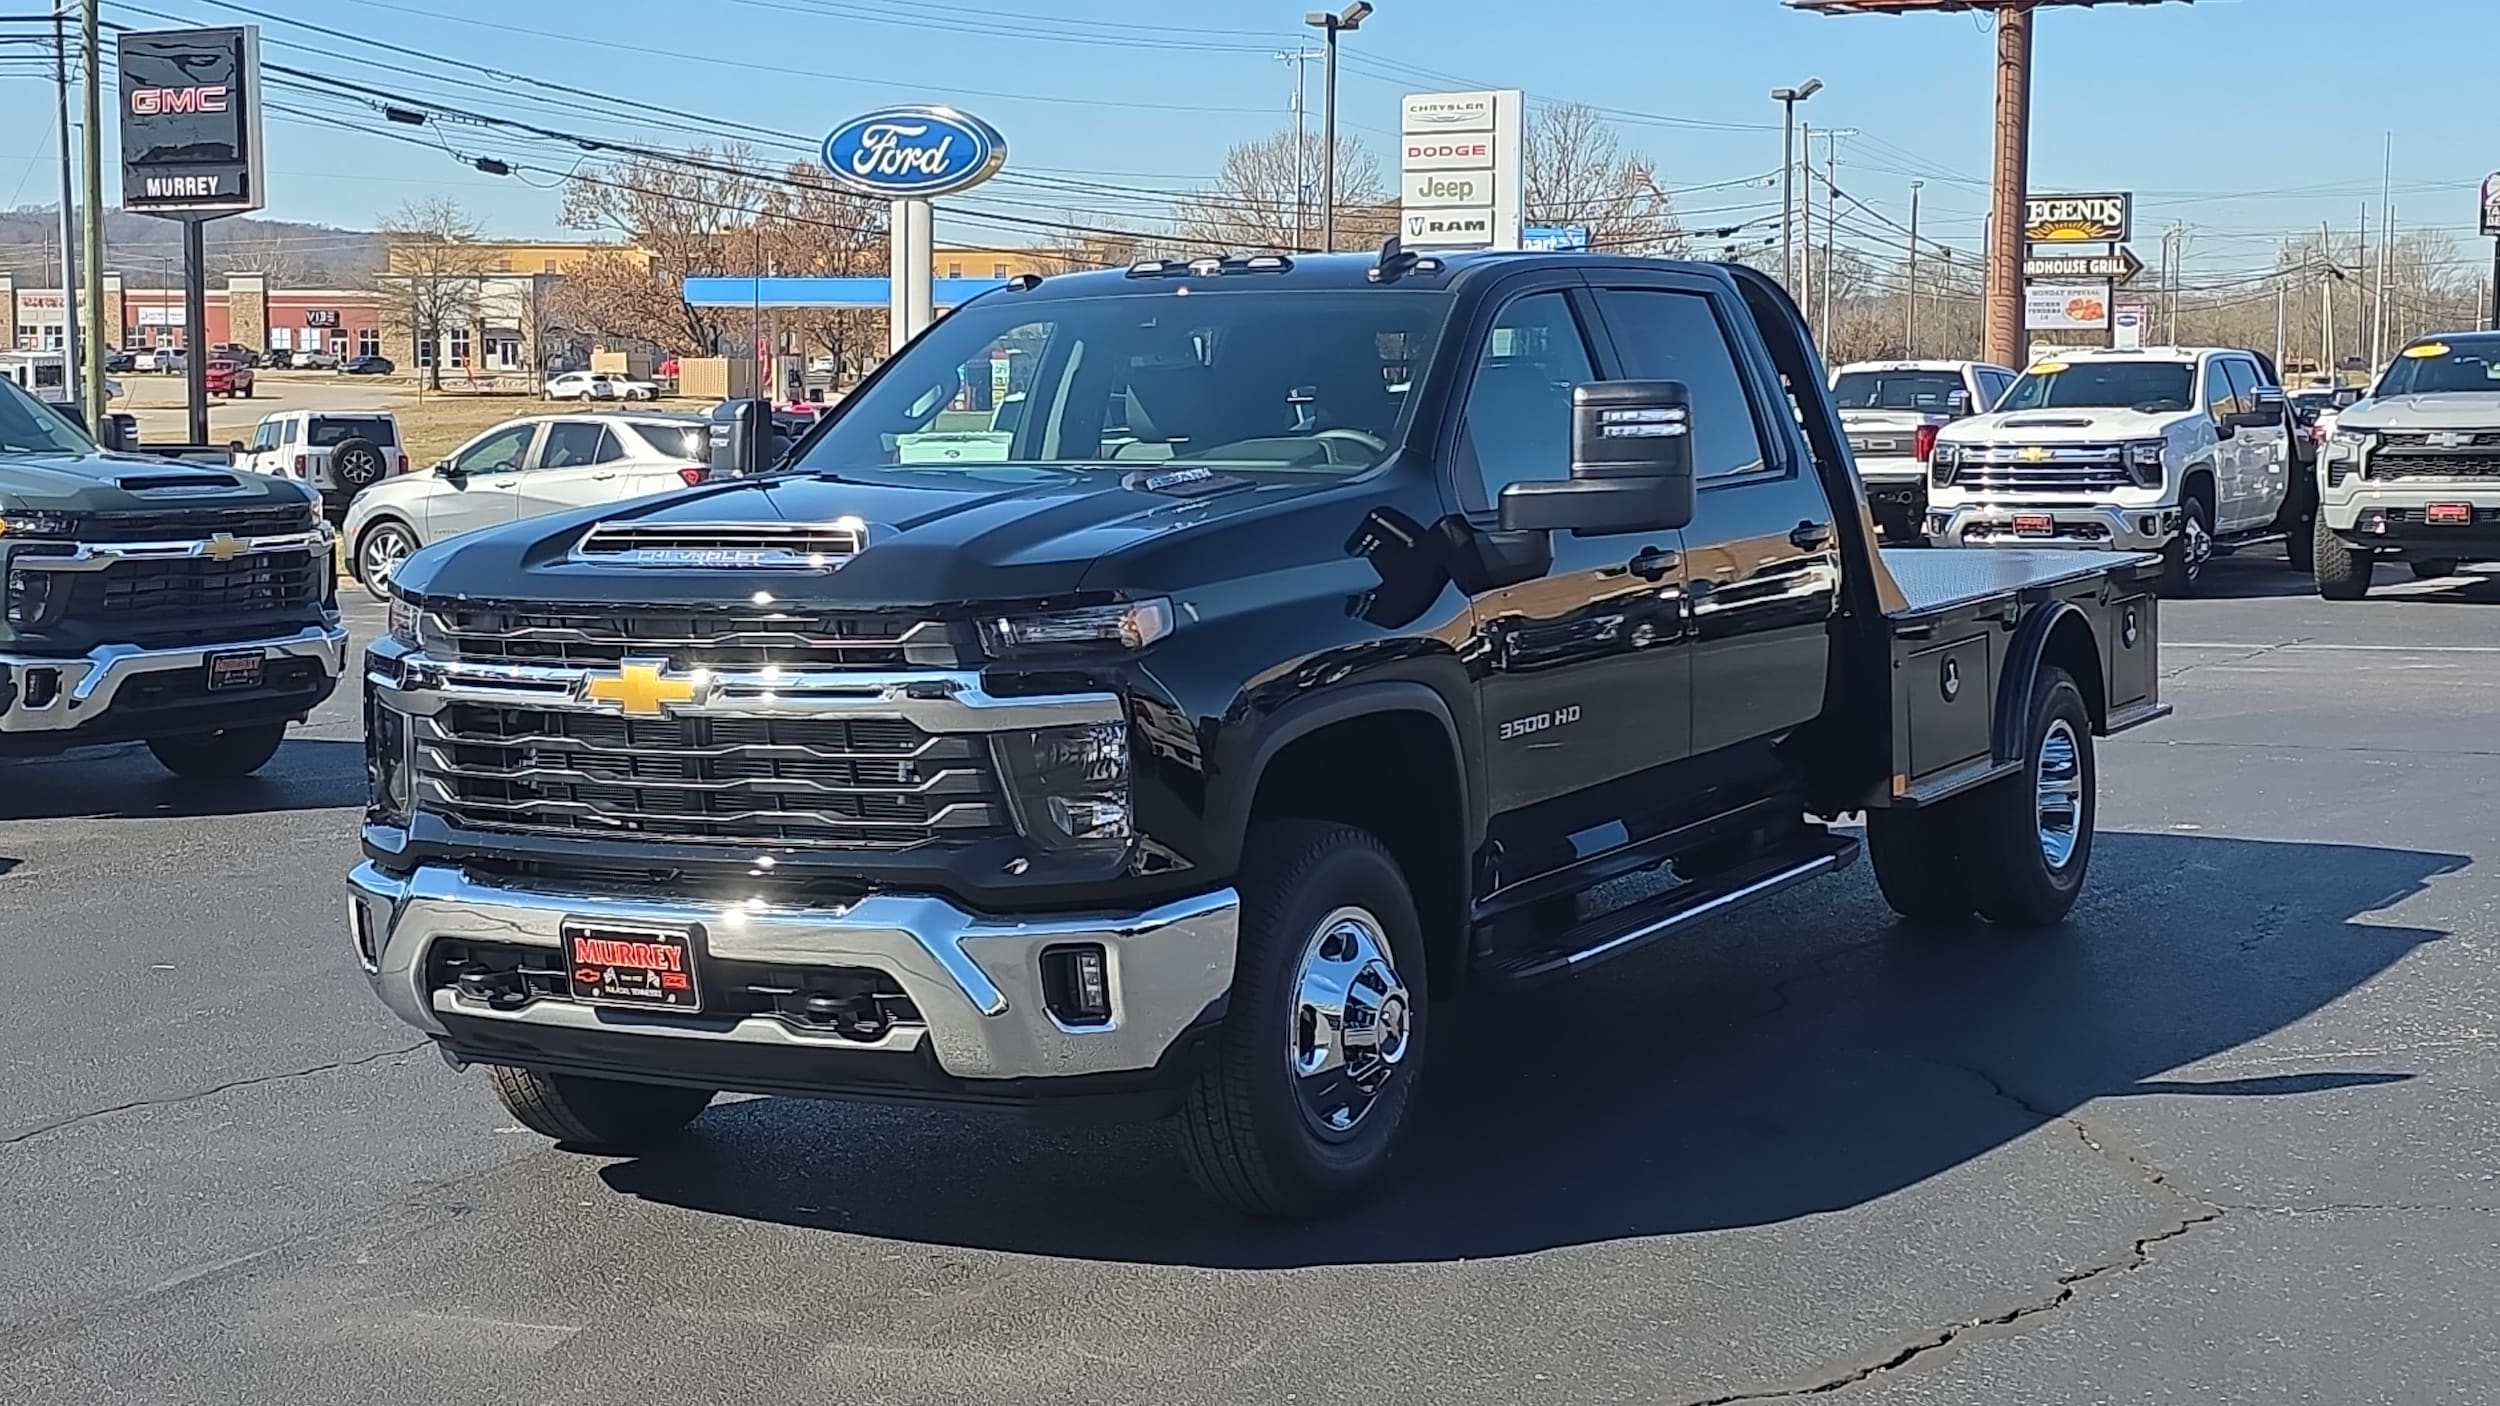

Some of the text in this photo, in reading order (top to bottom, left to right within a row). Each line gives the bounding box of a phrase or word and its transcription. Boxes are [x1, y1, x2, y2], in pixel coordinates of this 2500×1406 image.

[131, 86, 227, 115] GMC
[1410, 103, 1484, 113] CHRYSLER
[853, 124, 953, 176] Ford
[1408, 145, 1486, 157] DODGE
[146, 176, 218, 196] MURREY
[1418, 176, 1474, 201] Jeep
[2025, 199, 2121, 227] EGENDS
[1429, 221, 1485, 232] RAM
[2024, 260, 2128, 274] ADHOUSE GRILL
[1500, 705, 1580, 740] 3500 HD
[574, 937, 681, 972] MURREY
